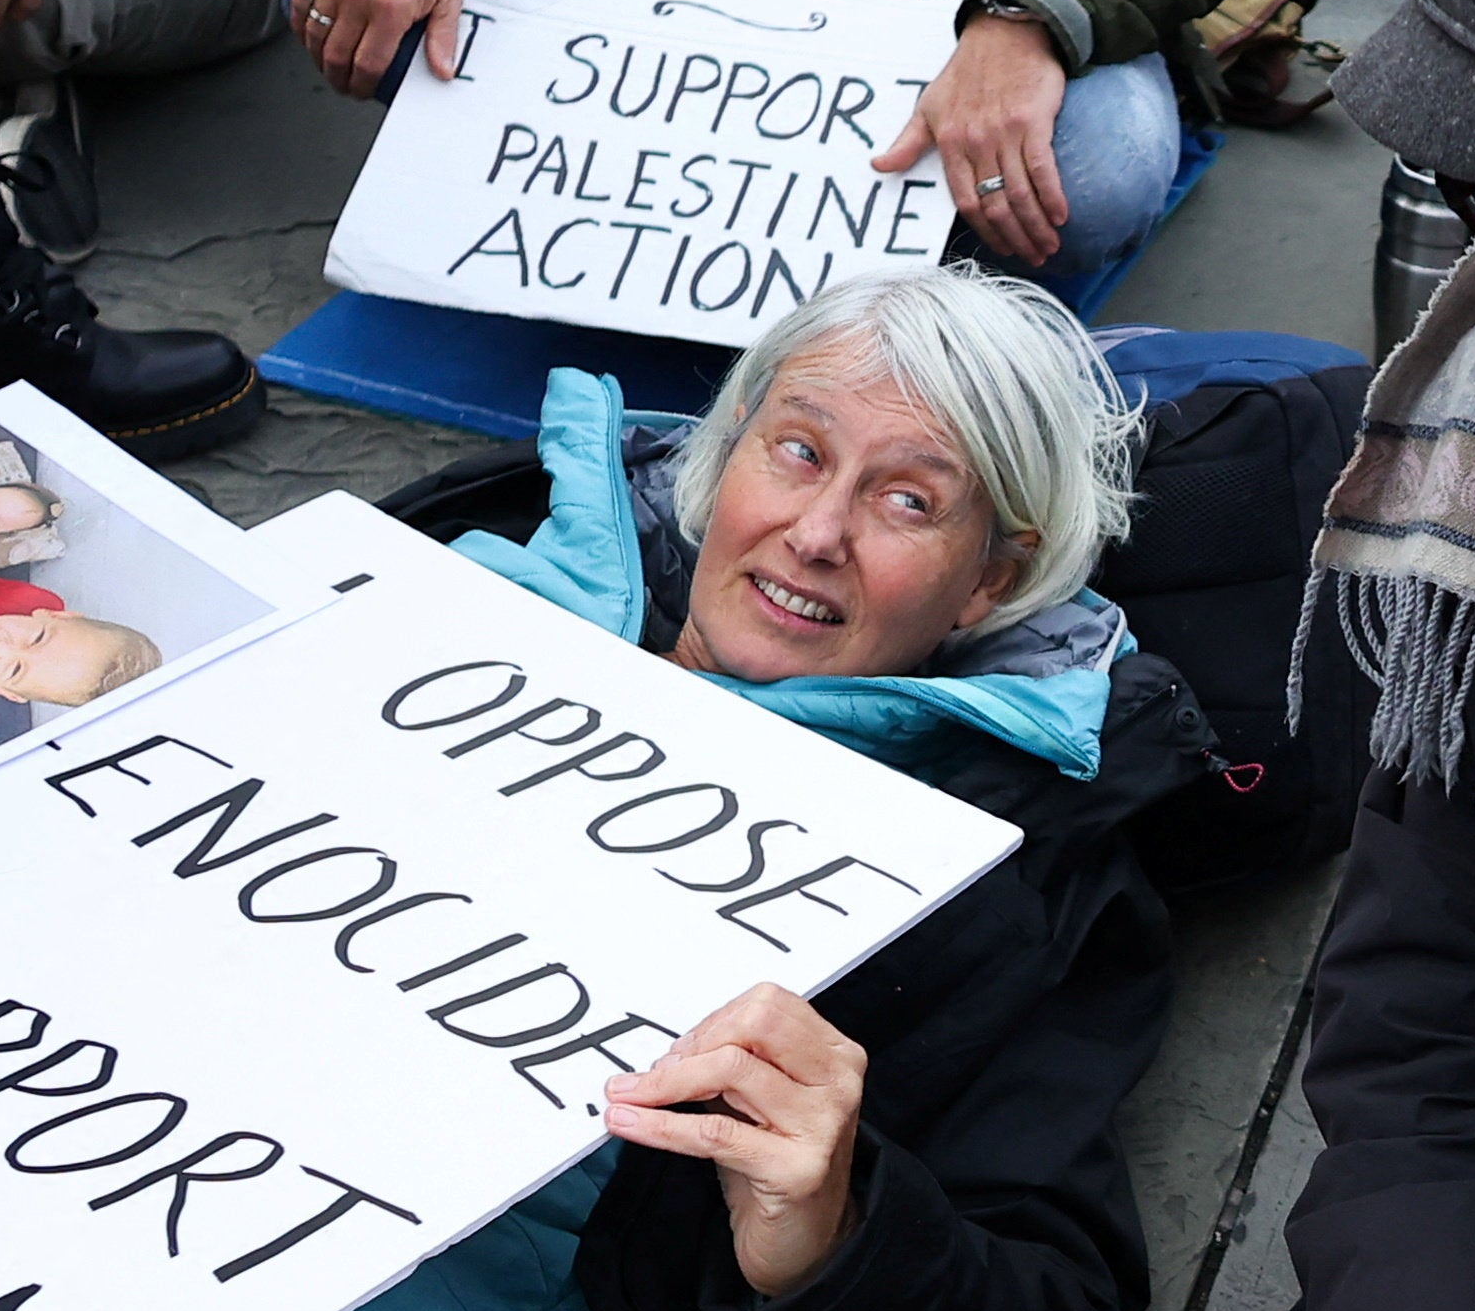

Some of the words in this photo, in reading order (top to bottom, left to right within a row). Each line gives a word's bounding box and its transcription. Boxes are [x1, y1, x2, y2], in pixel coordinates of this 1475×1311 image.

[451, 11, 494, 82] I
[486, 125, 937, 257] PALESTINE
[447, 209, 834, 318] ACTION
[381, 659, 923, 954] OPPOSE
[44, 735, 681, 1118] ENOCIDE.
